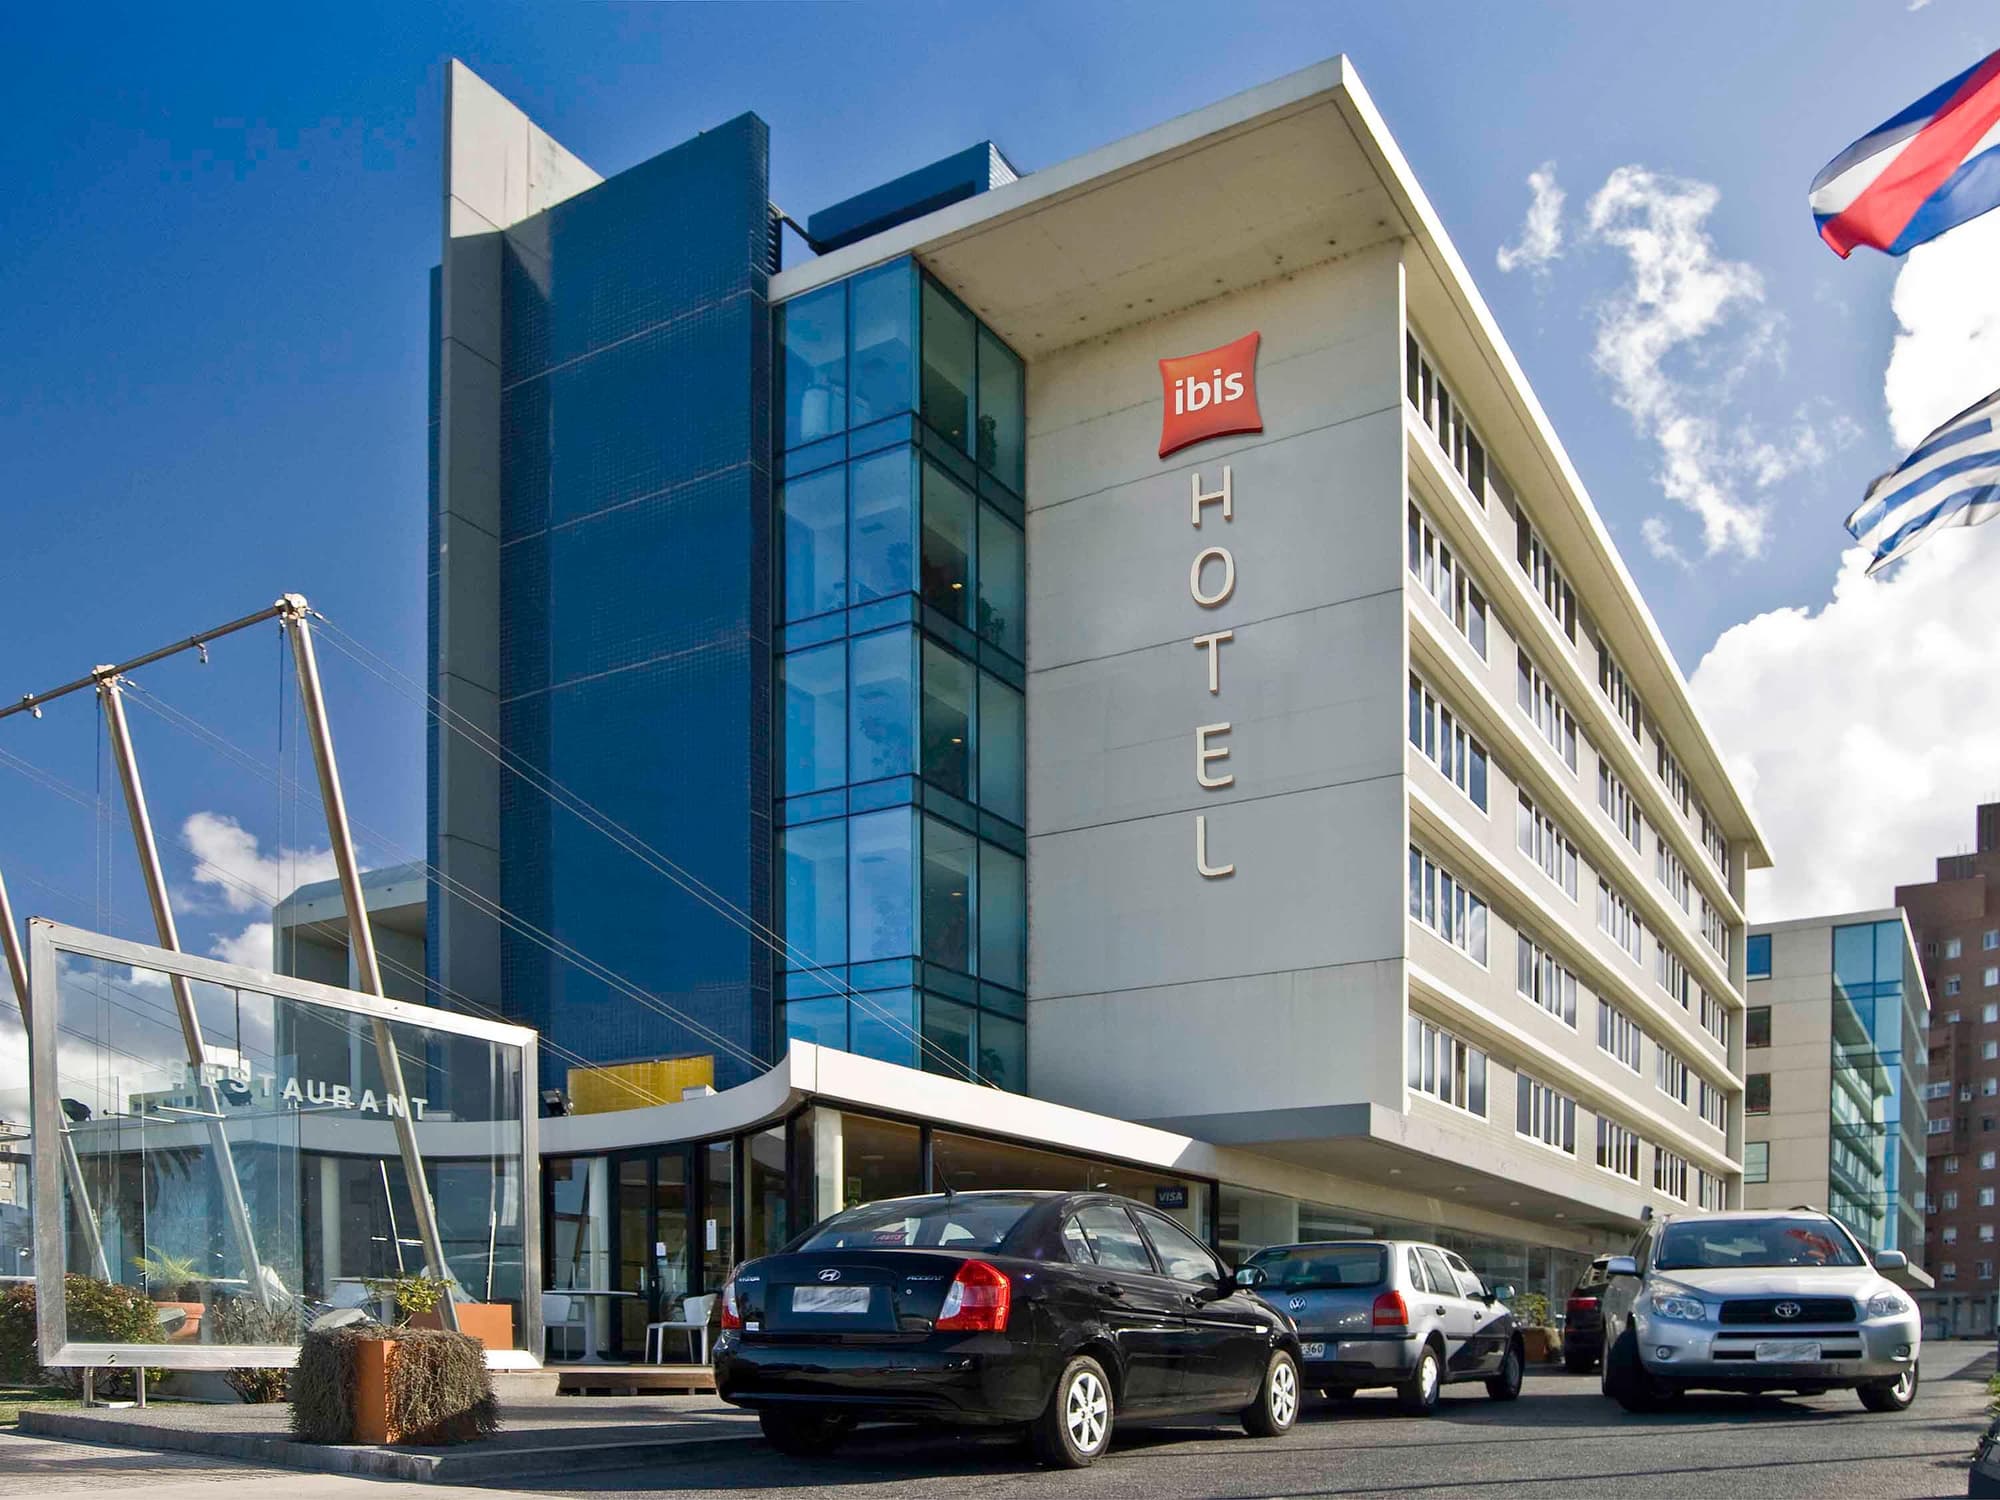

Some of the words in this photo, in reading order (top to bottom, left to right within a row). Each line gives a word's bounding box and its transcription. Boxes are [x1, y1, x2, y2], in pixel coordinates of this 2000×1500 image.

[1175, 368, 1244, 415] ibis
[1190, 465, 1236, 878] HOTEL
[168, 1060, 428, 1121] RESTAURANT
[1160, 1192, 1183, 1201] VISA
